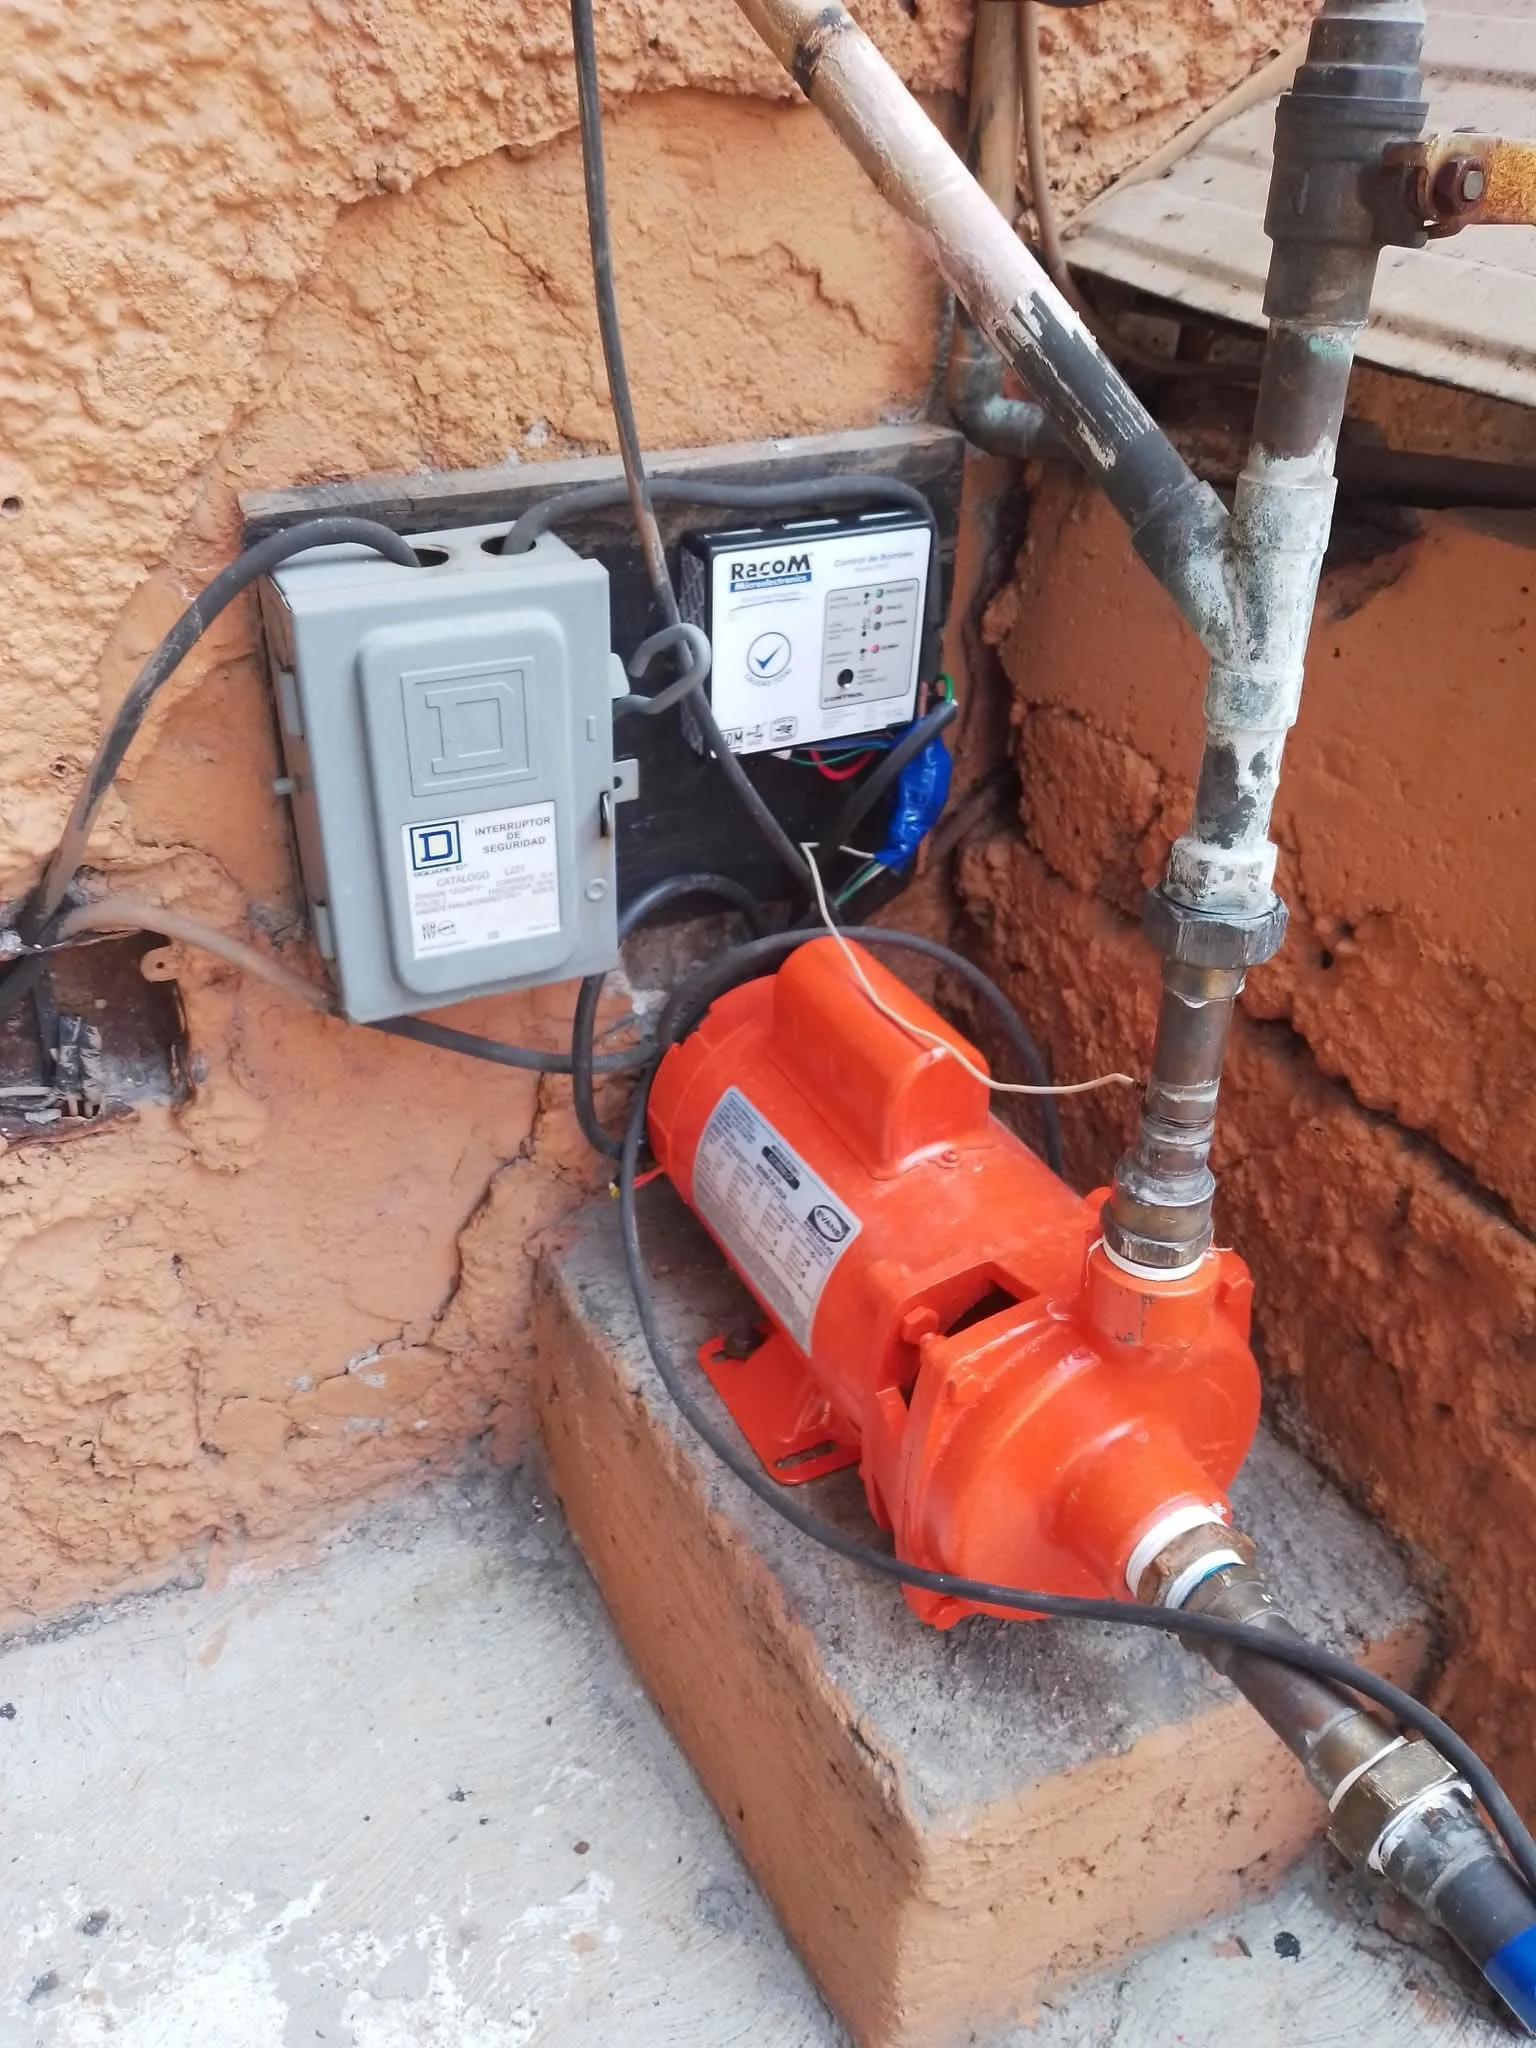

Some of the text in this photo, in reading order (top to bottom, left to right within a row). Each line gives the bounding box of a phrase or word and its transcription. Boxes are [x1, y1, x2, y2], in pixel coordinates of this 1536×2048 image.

[731, 554, 811, 581] RacoM
[475, 816, 552, 836] INTERRUPTOR
[482, 836, 547, 854] SEGURIDAD
[507, 832, 521, 840] DE
